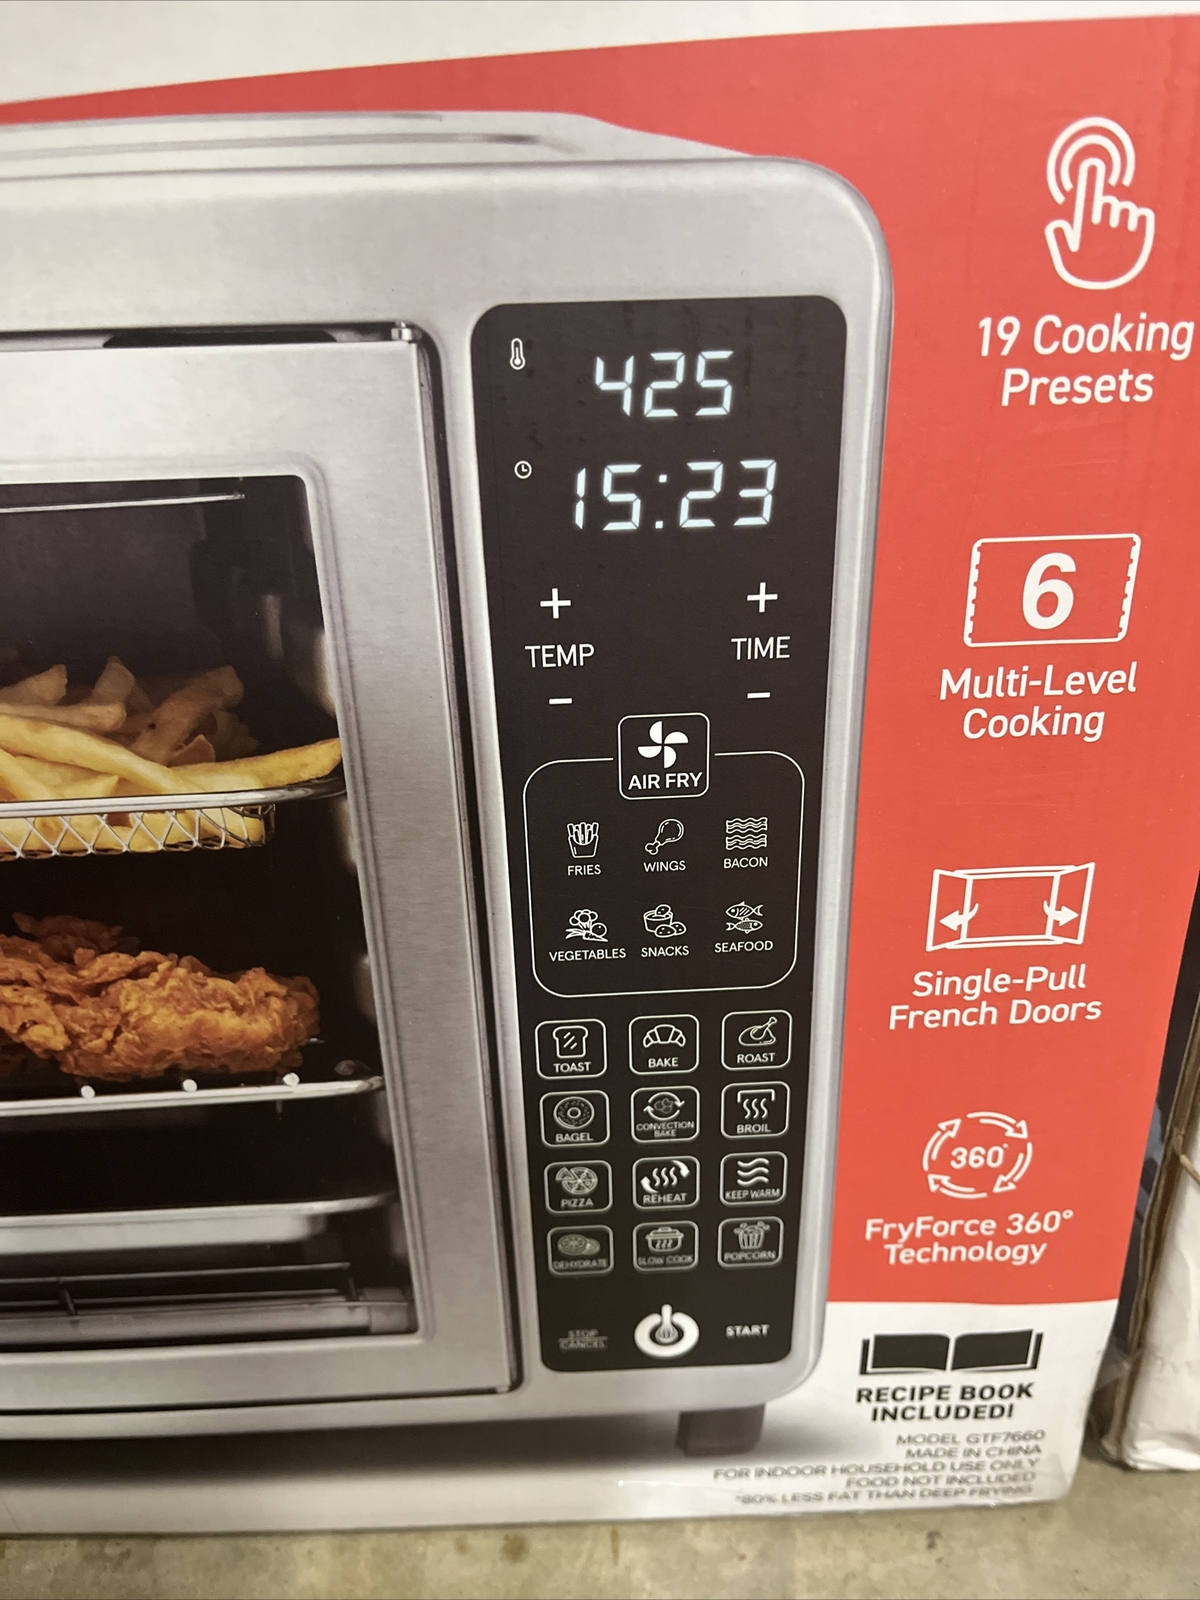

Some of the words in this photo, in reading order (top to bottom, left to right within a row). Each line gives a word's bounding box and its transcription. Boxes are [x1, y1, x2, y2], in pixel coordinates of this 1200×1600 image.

[978, 316, 1020, 357] 19
[1033, 312, 1194, 361] Cooking
[594, 350, 734, 418] 425
[1001, 368, 1155, 406] Presets
[574, 459, 777, 531] 15:23
[1022, 552, 1076, 630] 6
[731, 635, 790, 660] TIME
[525, 643, 595, 668] TEMP
[939, 661, 1137, 700] Multi-Level
[963, 705, 1105, 742] Cooking
[628, 774, 660, 790] AIR
[665, 772, 703, 788] FRY
[567, 864, 602, 876] FRIES
[643, 860, 686, 872] WINGS
[723, 856, 768, 869] BACON
[641, 945, 690, 958] SNACKS
[714, 940, 774, 953] SEAFOOD
[549, 948, 626, 962] VEGETABLES
[912, 963, 1086, 1001] Single-Pull
[889, 1000, 998, 1030] French
[1009, 998, 1102, 1024] Doors
[648, 1057, 679, 1068] BAKE
[736, 1053, 776, 1064] ROAST
[553, 1061, 591, 1073] TOAST
[636, 1121, 694, 1131] CONVECTION
[654, 1129, 677, 1138] BAKE
[736, 1123, 772, 1134] BROIL
[555, 1132, 594, 1143] BAGEL
[643, 1193, 687, 1204] REHEAT
[725, 1190, 748, 1201] KEEP
[750, 1188, 781, 1199] WARM
[560, 1198, 594, 1209] PIZZA
[865, 1215, 997, 1243] FryForce
[637, 1256, 664, 1266] SLOW
[665, 1254, 694, 1265] COOK
[723, 1250, 776, 1262] POPCORN
[884, 1240, 1047, 1266] Technology
[552, 1258, 608, 1270] DEHYDRATE
[725, 1323, 770, 1338] START
[856, 1385, 951, 1403] RECIPE
[959, 1382, 1035, 1400] BOOK
[871, 1403, 1014, 1422] INCLUDED!
[896, 1432, 961, 1446] MODEL
[965, 1429, 1045, 1445] GTF7660
[905, 1447, 959, 1459] MADE
[962, 1447, 982, 1458] IN
[985, 1444, 1042, 1458] CHINA
[713, 1467, 751, 1480] FOR
[754, 1465, 827, 1478] INDOOR
[831, 1460, 946, 1476] HOUSEHOLD
[949, 1460, 986, 1473] USE
[989, 1457, 1040, 1472] ONLY
[846, 1476, 899, 1488] FOOD
[903, 1474, 943, 1486] NOT
[945, 1471, 1037, 1485] INCLUDED
[781, 1491, 824, 1503] LESS
[828, 1489, 861, 1502] FAT
[918, 1487, 966, 1498] DEEP
